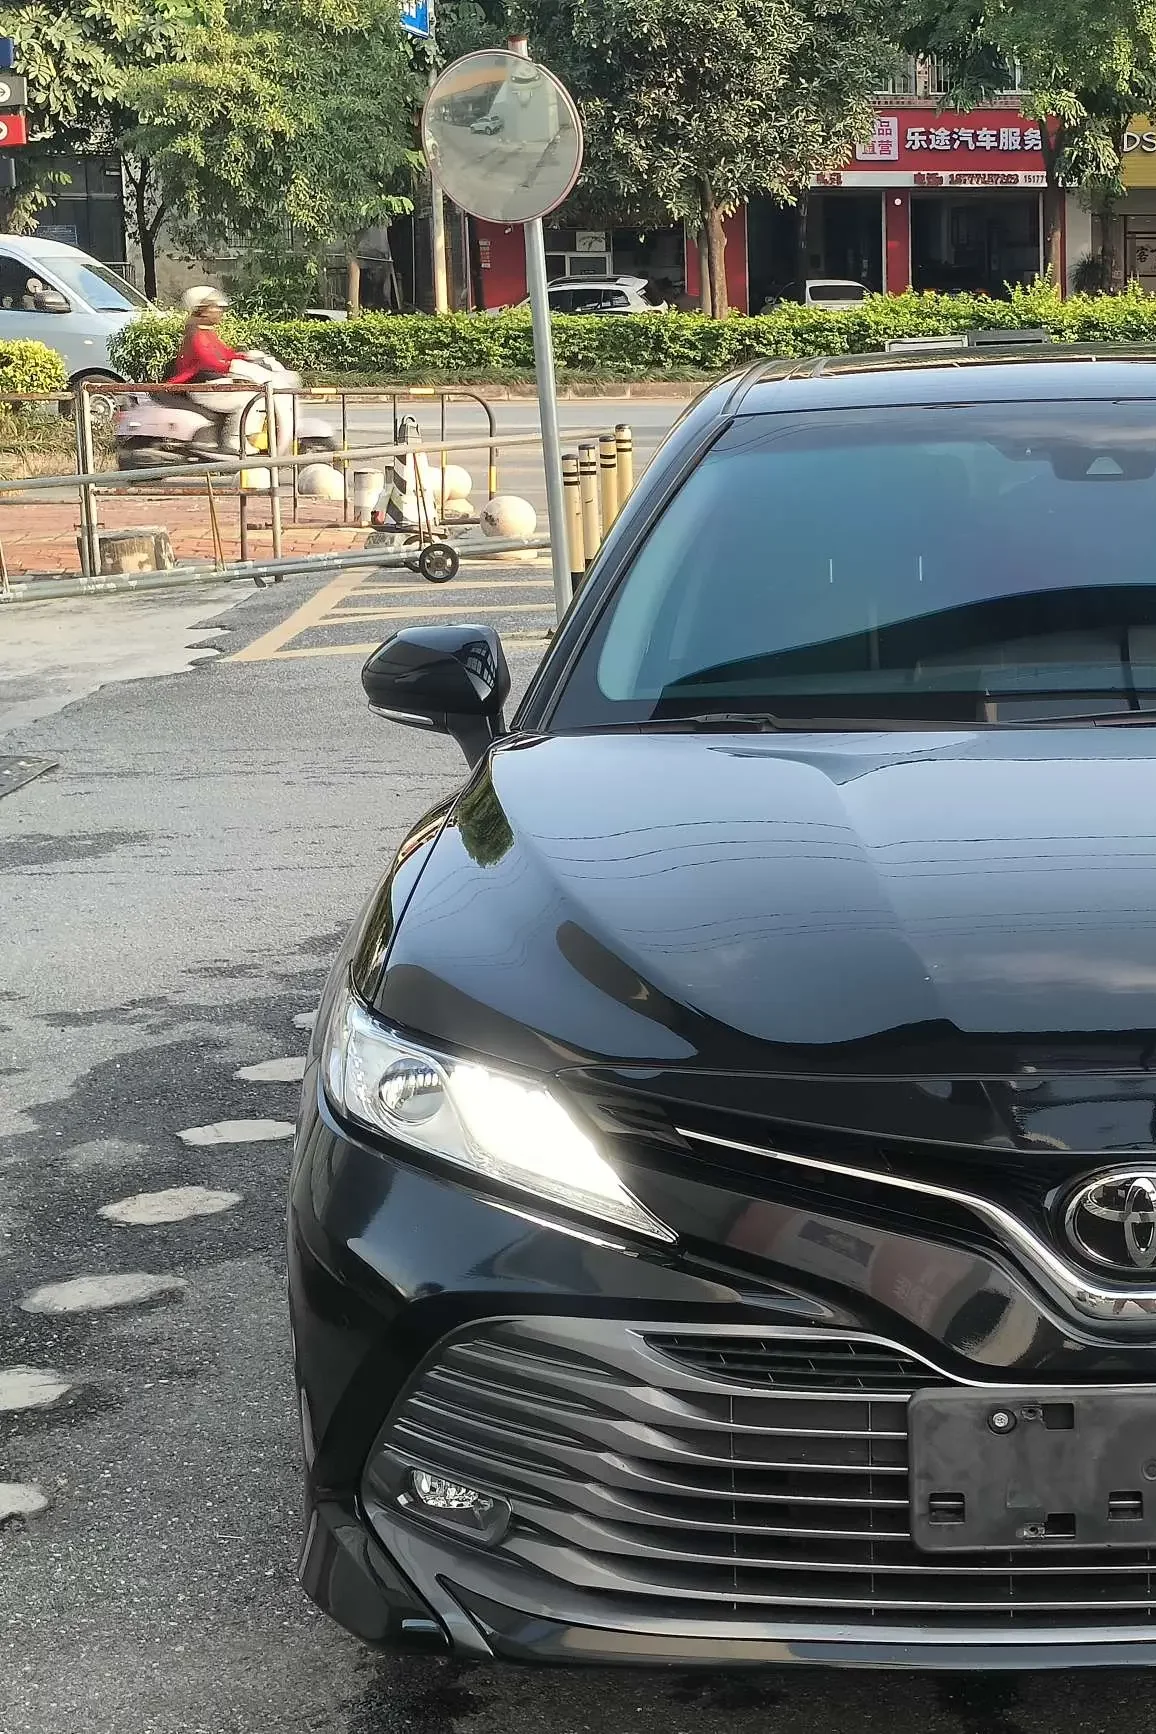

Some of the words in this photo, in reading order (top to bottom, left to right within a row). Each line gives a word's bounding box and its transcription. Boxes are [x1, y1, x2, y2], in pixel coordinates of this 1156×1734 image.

[904, 127, 1042, 151] 乐途汽车服务
[1024, 175, 1047, 184] 15177
